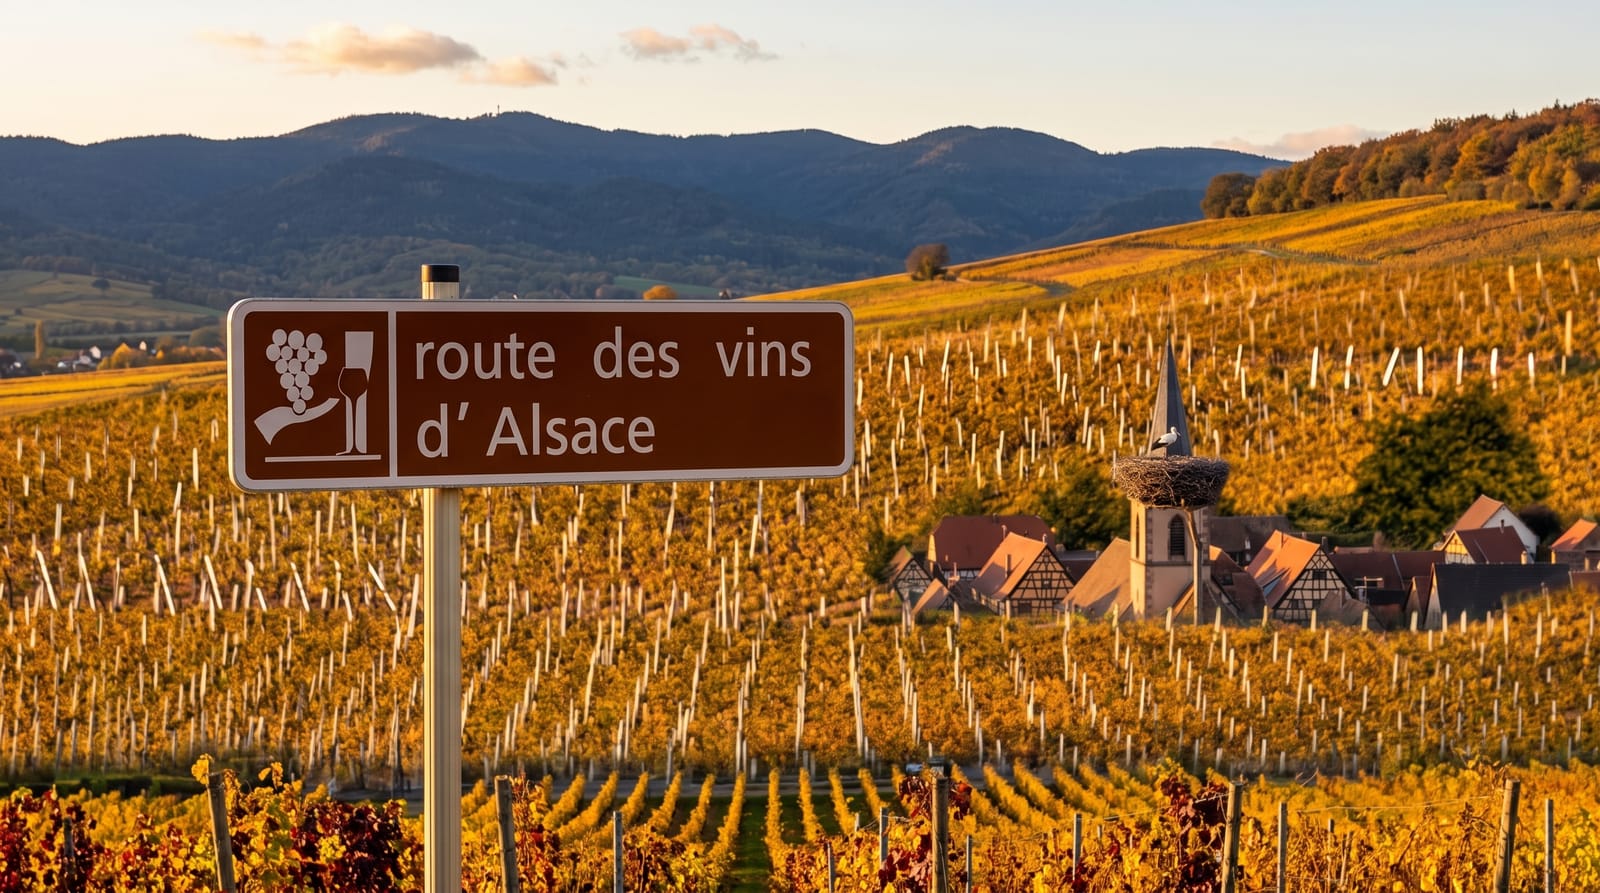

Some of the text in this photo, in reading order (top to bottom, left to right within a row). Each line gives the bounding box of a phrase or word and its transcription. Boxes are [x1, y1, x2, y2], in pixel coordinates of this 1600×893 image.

[415, 326, 812, 380] route des vins
[486, 402, 656, 457] Alsace
